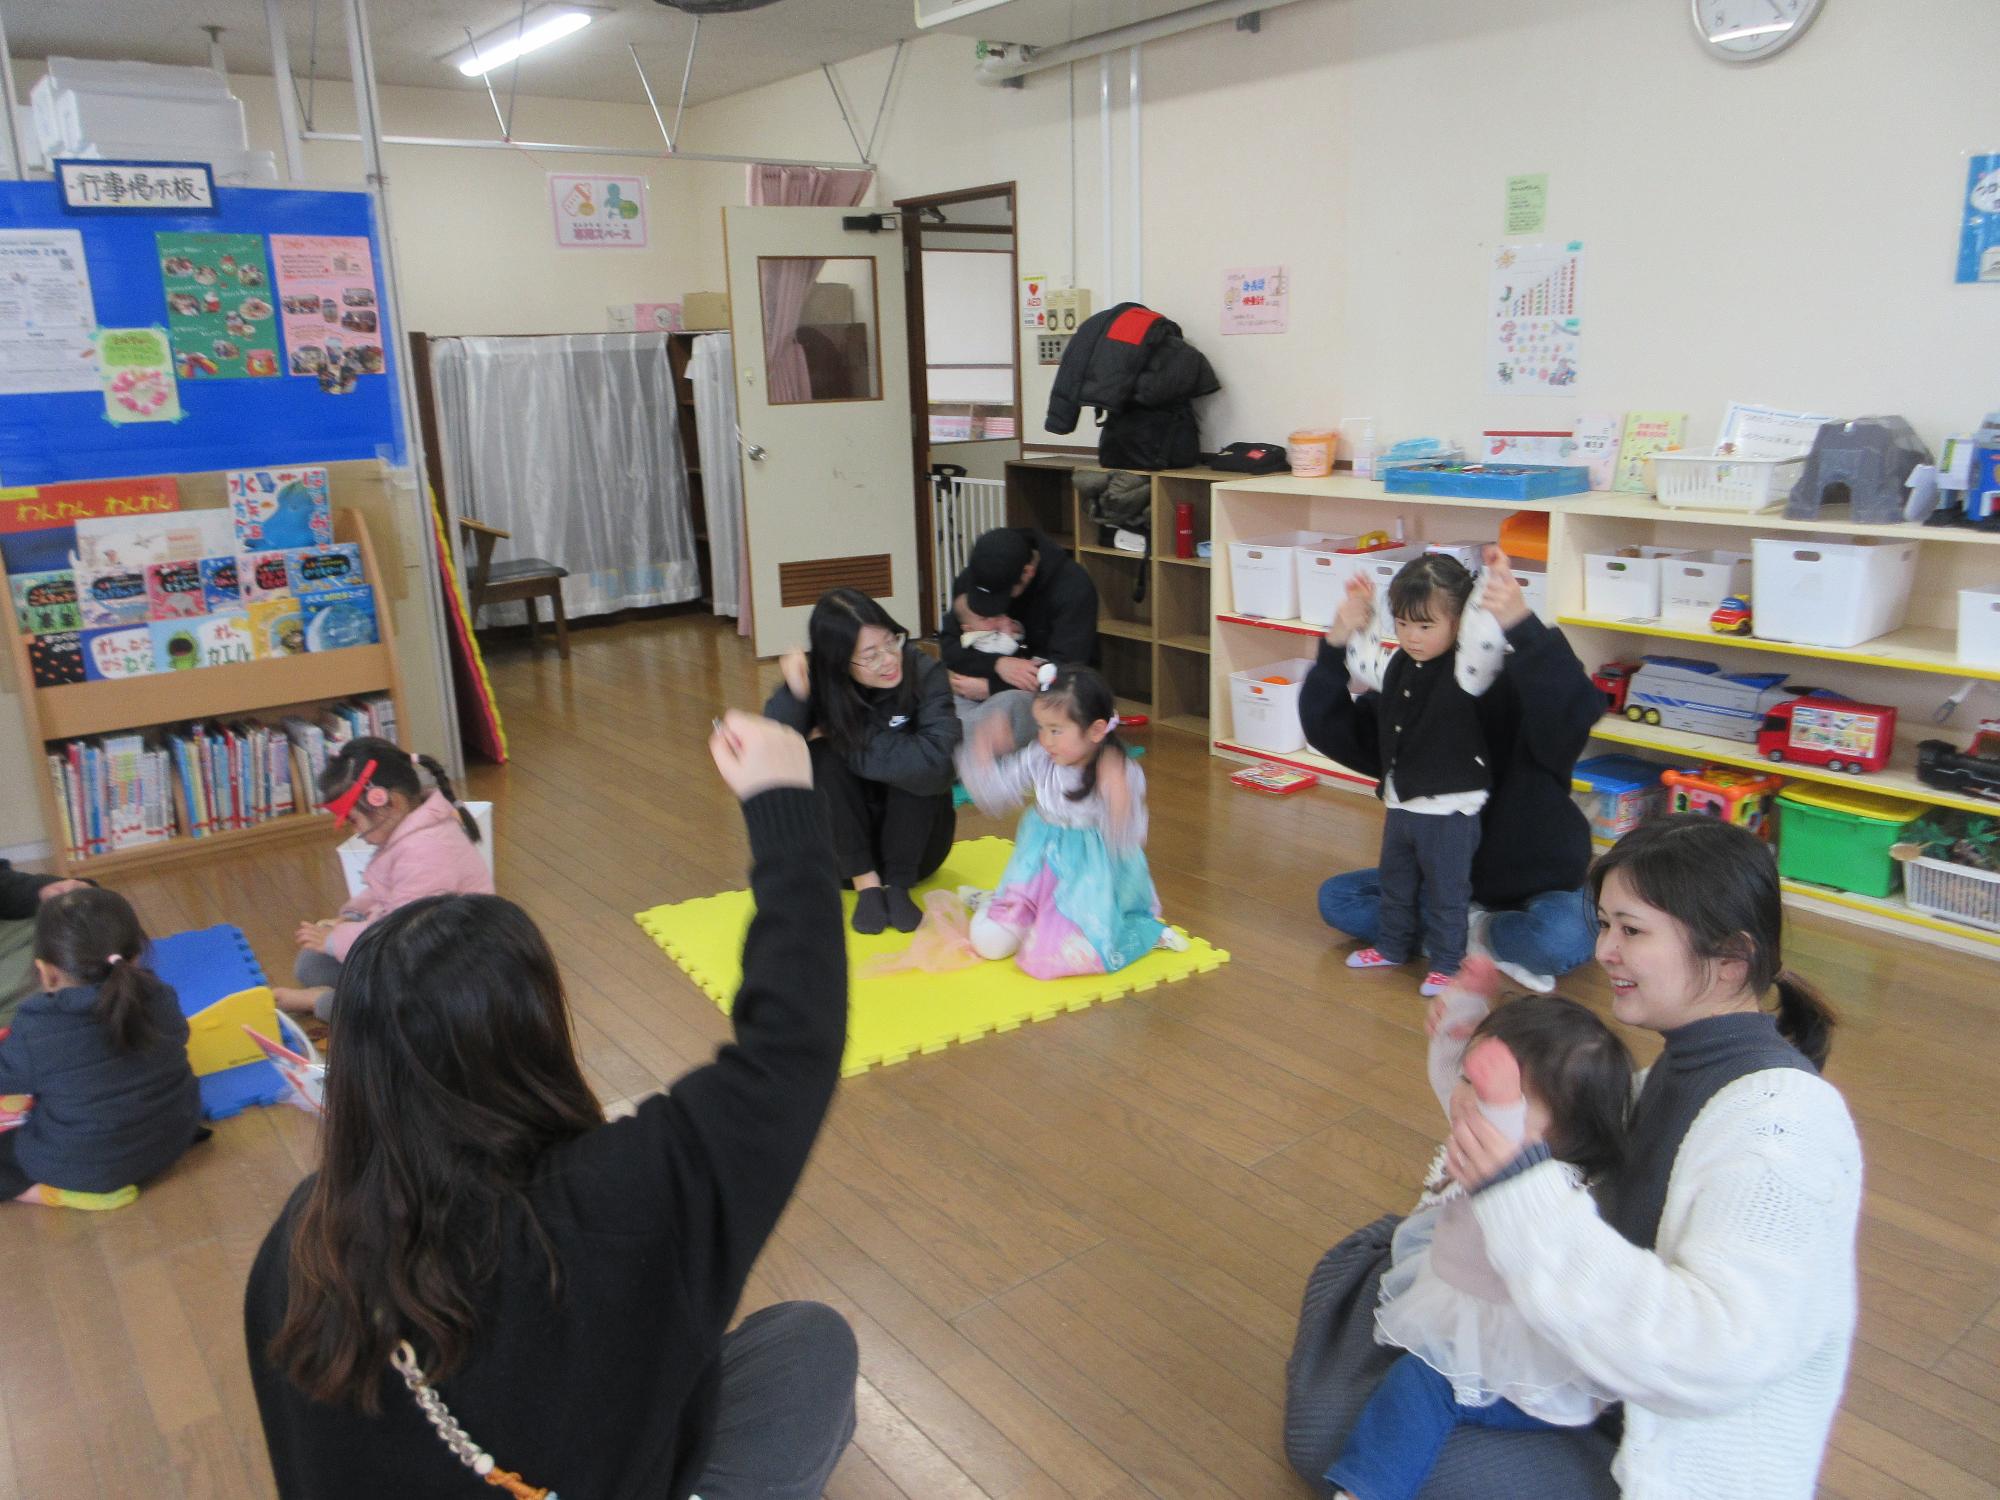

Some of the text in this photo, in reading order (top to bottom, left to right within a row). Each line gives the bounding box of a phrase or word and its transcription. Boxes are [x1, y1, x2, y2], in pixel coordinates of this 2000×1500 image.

[76, 171, 202, 202] 行事掲示板
